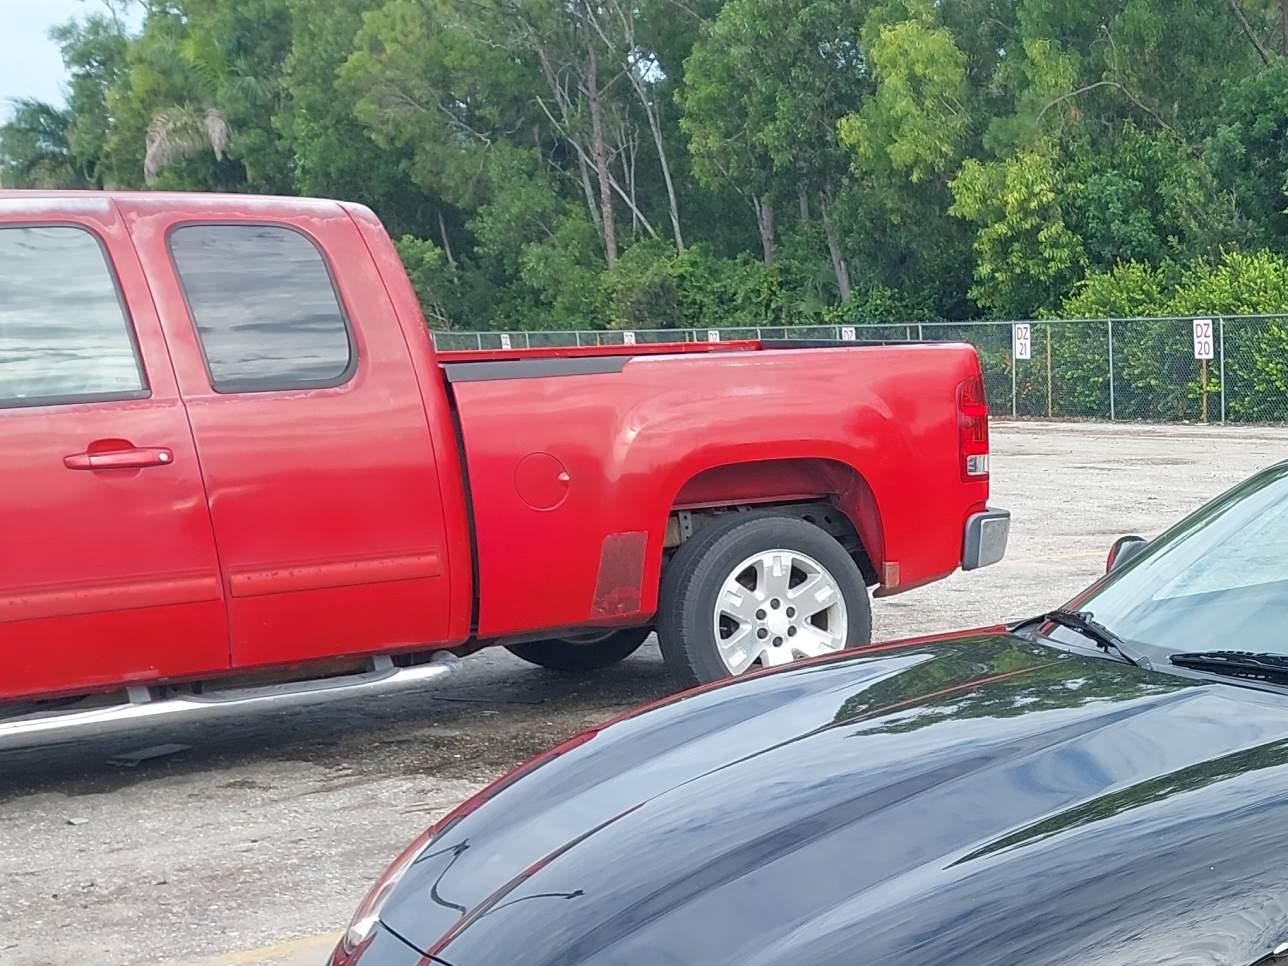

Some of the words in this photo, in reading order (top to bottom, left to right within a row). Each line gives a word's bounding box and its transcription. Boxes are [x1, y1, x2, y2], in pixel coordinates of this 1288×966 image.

[1017, 326, 1029, 340] DZ
[1195, 323, 1211, 338] DZ
[1019, 341, 1027, 355] 21
[1196, 340, 1210, 355] 20
